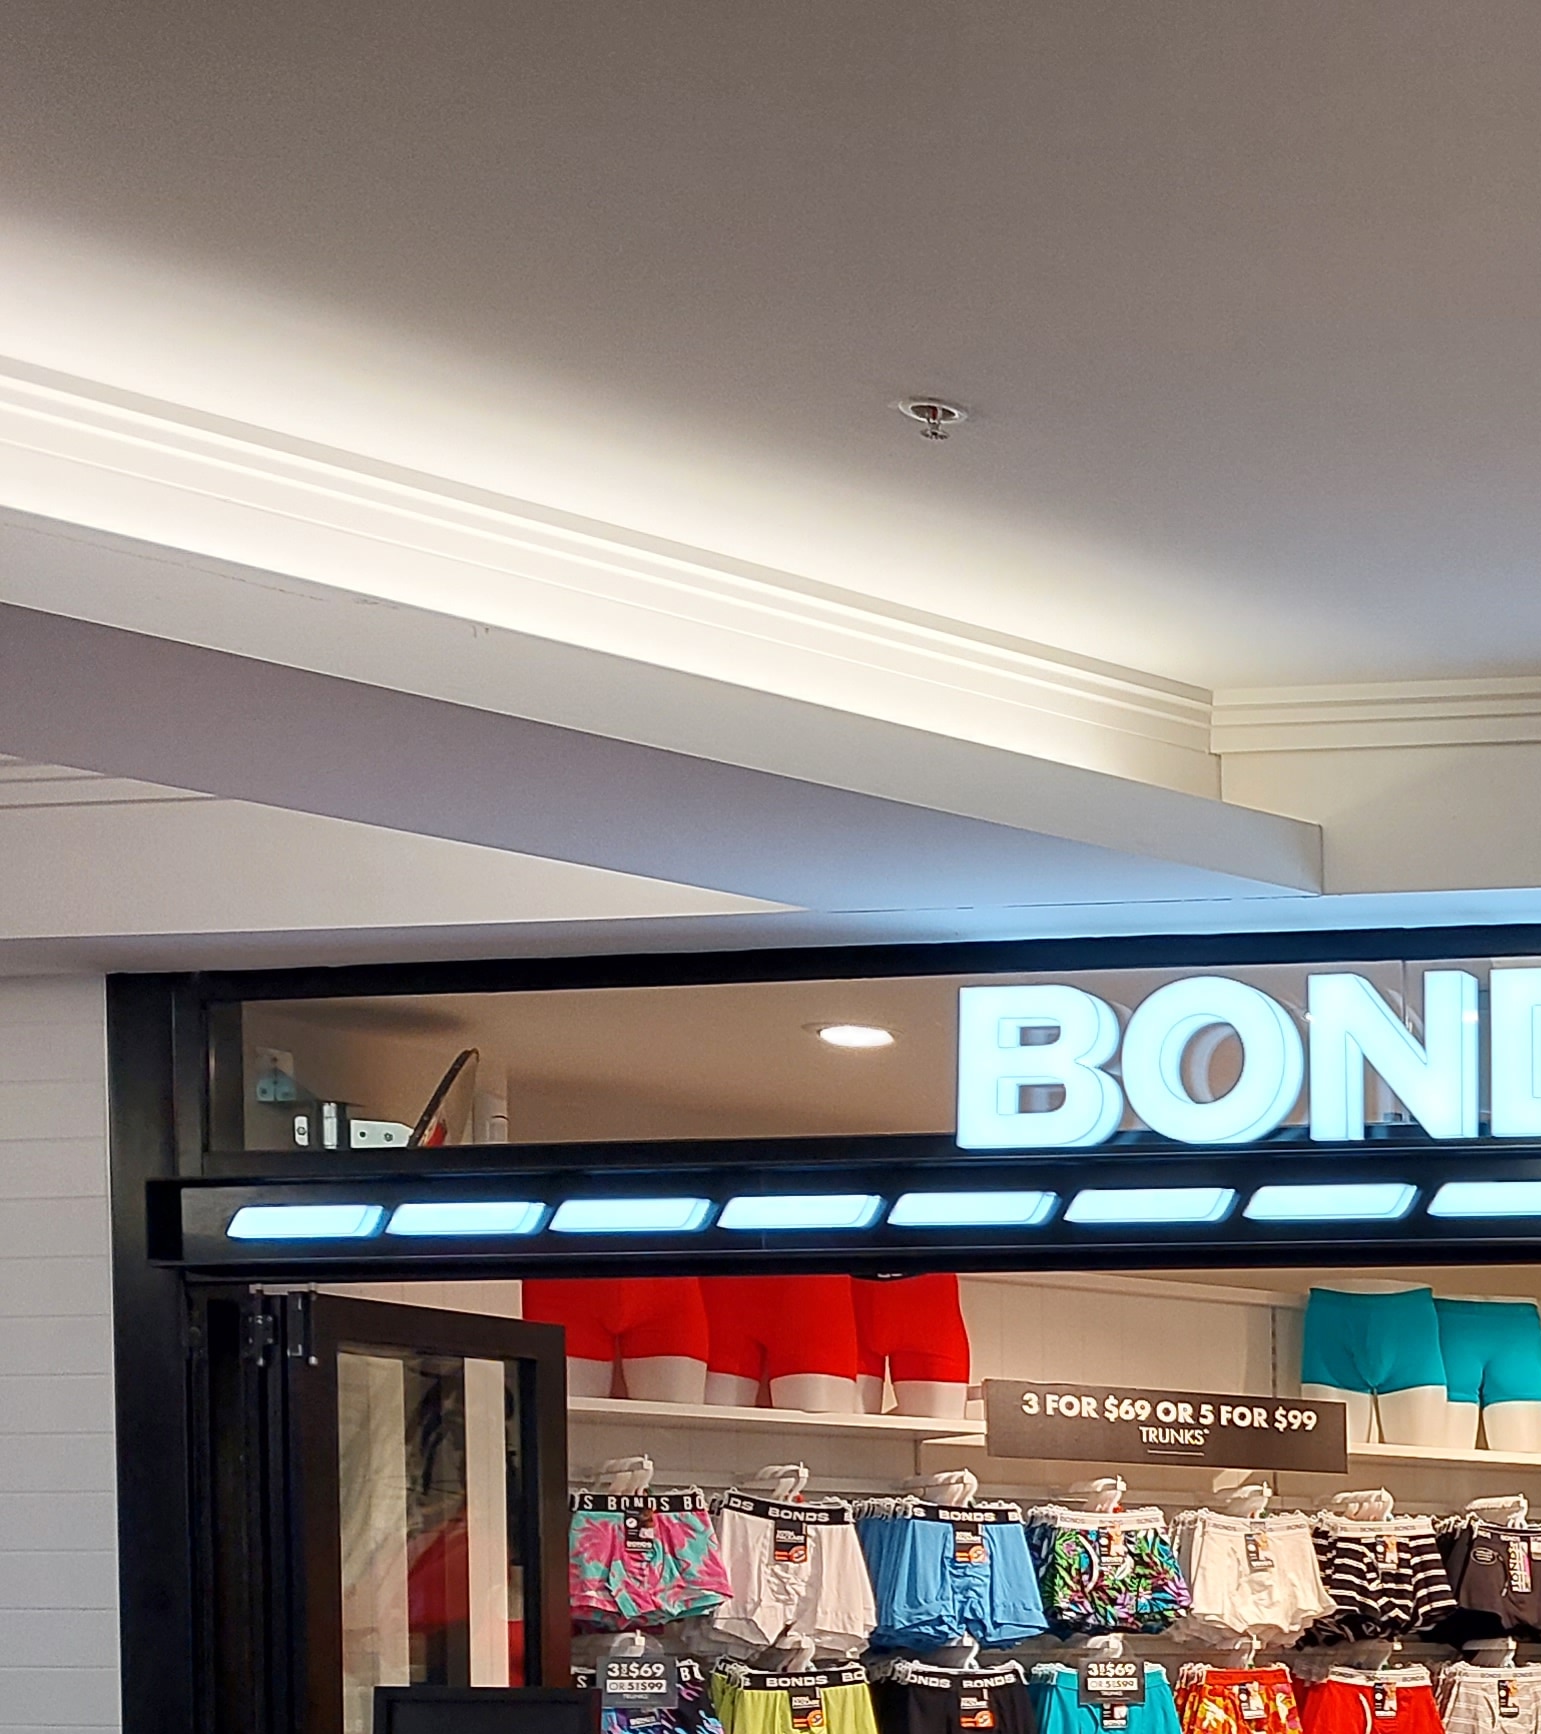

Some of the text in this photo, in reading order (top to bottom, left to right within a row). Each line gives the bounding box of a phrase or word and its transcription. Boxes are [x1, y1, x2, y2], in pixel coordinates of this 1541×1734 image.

[1022, 1393, 1318, 1432] 3 FOR $69 OR 5 FOR $99
[608, 1496, 670, 1511] BONDS
[768, 1508, 831, 1522] BONDS
[938, 1509, 996, 1522] BONDS
[607, 1663, 620, 1677] 3
[629, 1662, 665, 1678] $69
[1088, 1662, 1136, 1677] 3 $69
[609, 1682, 663, 1691] OR 5 $99
[766, 1675, 828, 1687] BONDS
[962, 1674, 1016, 1688] BONDS
